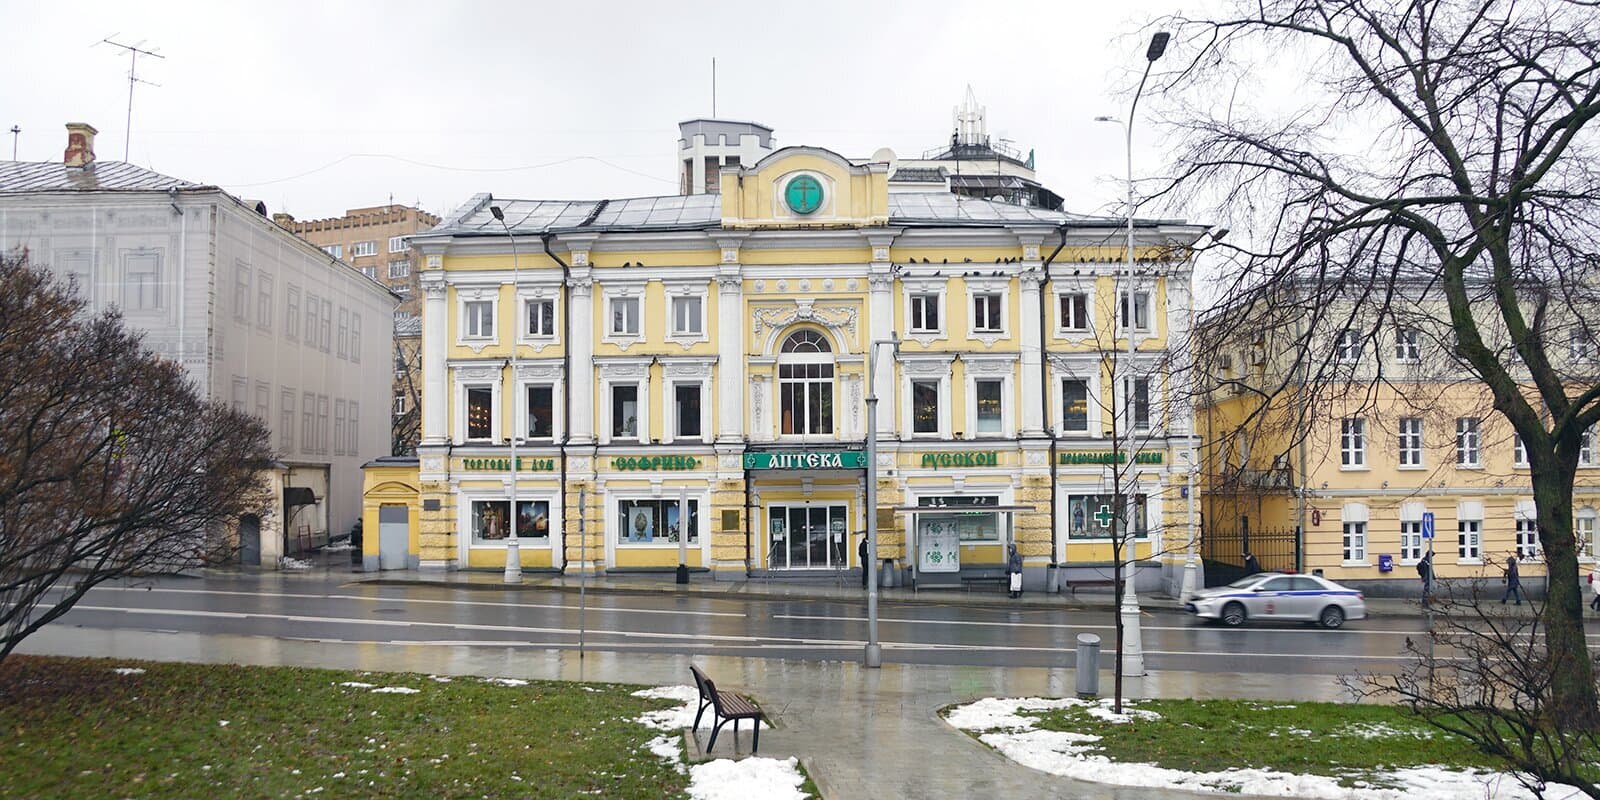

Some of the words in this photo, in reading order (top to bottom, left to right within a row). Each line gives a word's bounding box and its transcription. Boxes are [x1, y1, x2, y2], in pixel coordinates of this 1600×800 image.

[463, 455, 522, 471] ТОРГОВЫЙ
[532, 458, 554, 471] ДОМ
[616, 455, 696, 471] СОФРИНО
[768, 453, 843, 468] АПТЕКА
[921, 450, 997, 471] РУССКОЙ
[1060, 450, 1126, 464] ПРАВОСЛАВНЙ
[1135, 451, 1163, 464] ЕРКВИ
